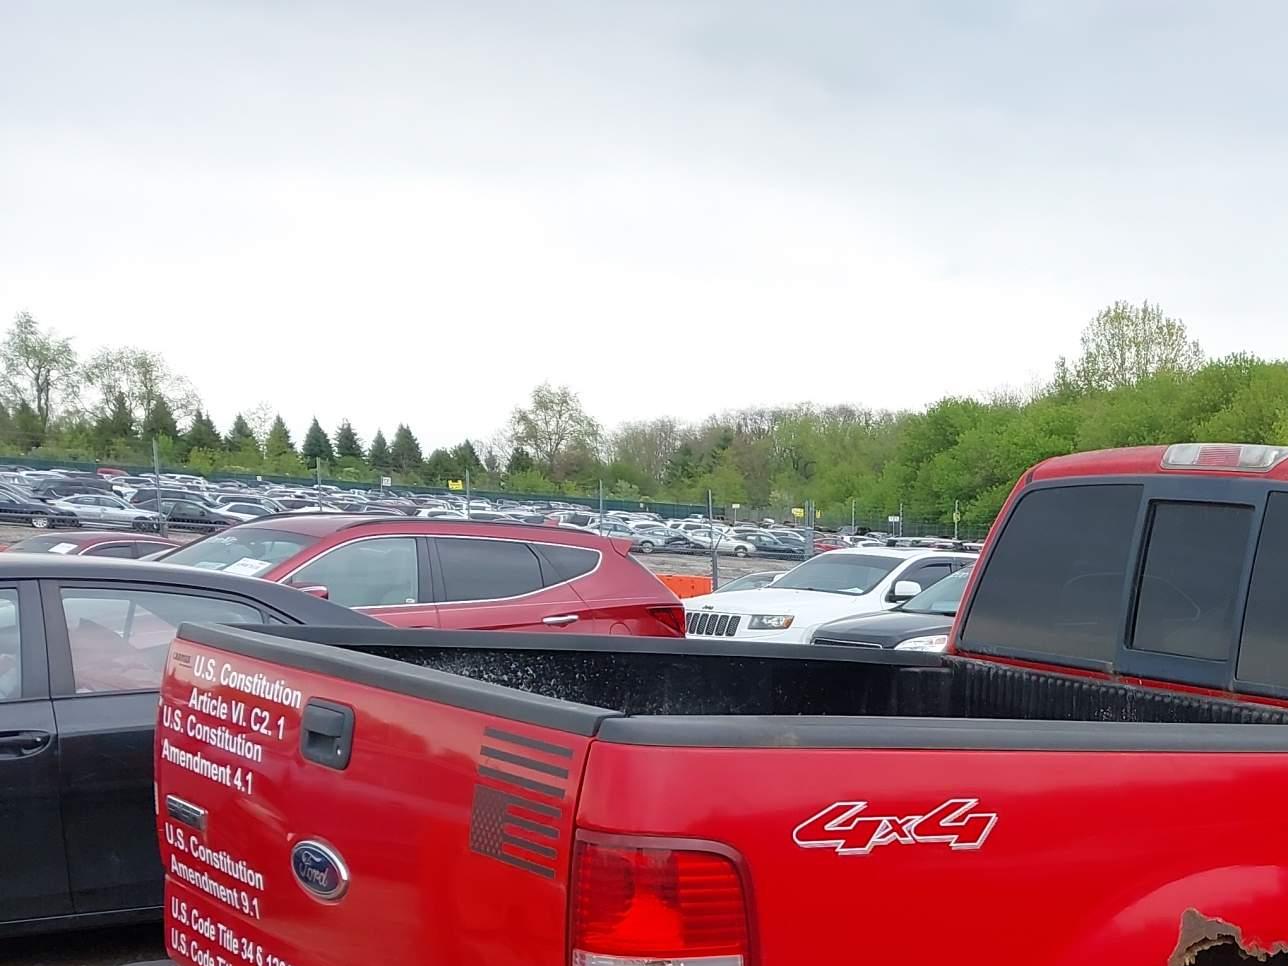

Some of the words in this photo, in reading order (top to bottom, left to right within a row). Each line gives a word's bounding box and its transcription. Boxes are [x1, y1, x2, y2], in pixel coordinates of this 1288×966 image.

[194, 655, 216, 682] U.S.
[220, 663, 302, 709] Constitution
[163, 705, 184, 733] U.S.
[187, 715, 262, 762] Constitution
[188, 687, 228, 720] Article
[231, 700, 246, 727] VI.
[250, 708, 272, 736] C2.
[277, 716, 285, 740] 1
[161, 738, 232, 786] Amendment
[233, 767, 253, 795] 4.1
[793, 798, 998, 856] 4x4
[165, 822, 188, 852] U.S.
[190, 836, 264, 890] Constitution
[299, 850, 329, 887] Ford
[171, 854, 240, 909] Amendment
[241, 890, 260, 920] 9.1
[171, 896, 189, 926] U.S.
[191, 909, 215, 941] Code
[217, 923, 239, 954] Title
[241, 938, 254, 963] 34
[171, 928, 188, 957] U.S.
